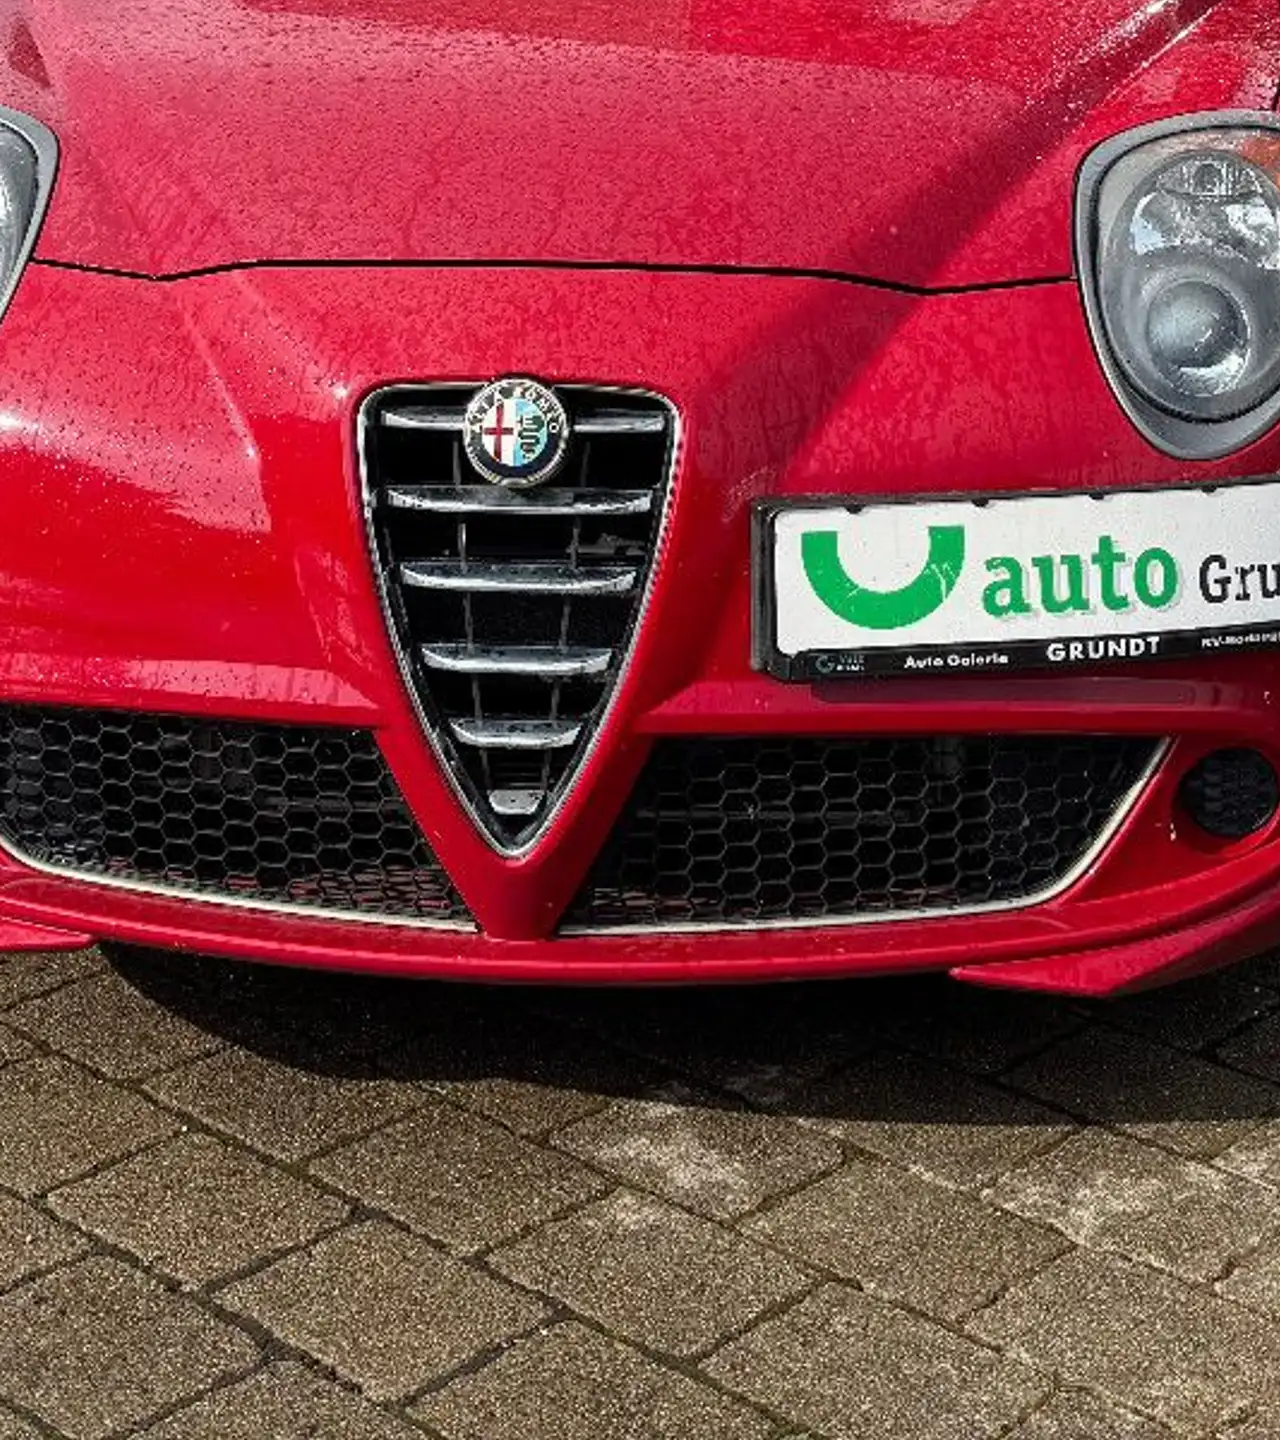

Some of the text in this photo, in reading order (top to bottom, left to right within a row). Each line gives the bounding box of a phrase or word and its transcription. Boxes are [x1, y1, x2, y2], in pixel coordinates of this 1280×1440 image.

[982, 535, 1179, 617] auto
[903, 655, 944, 669] Auto
[1046, 636, 1162, 662] GRUNDT
